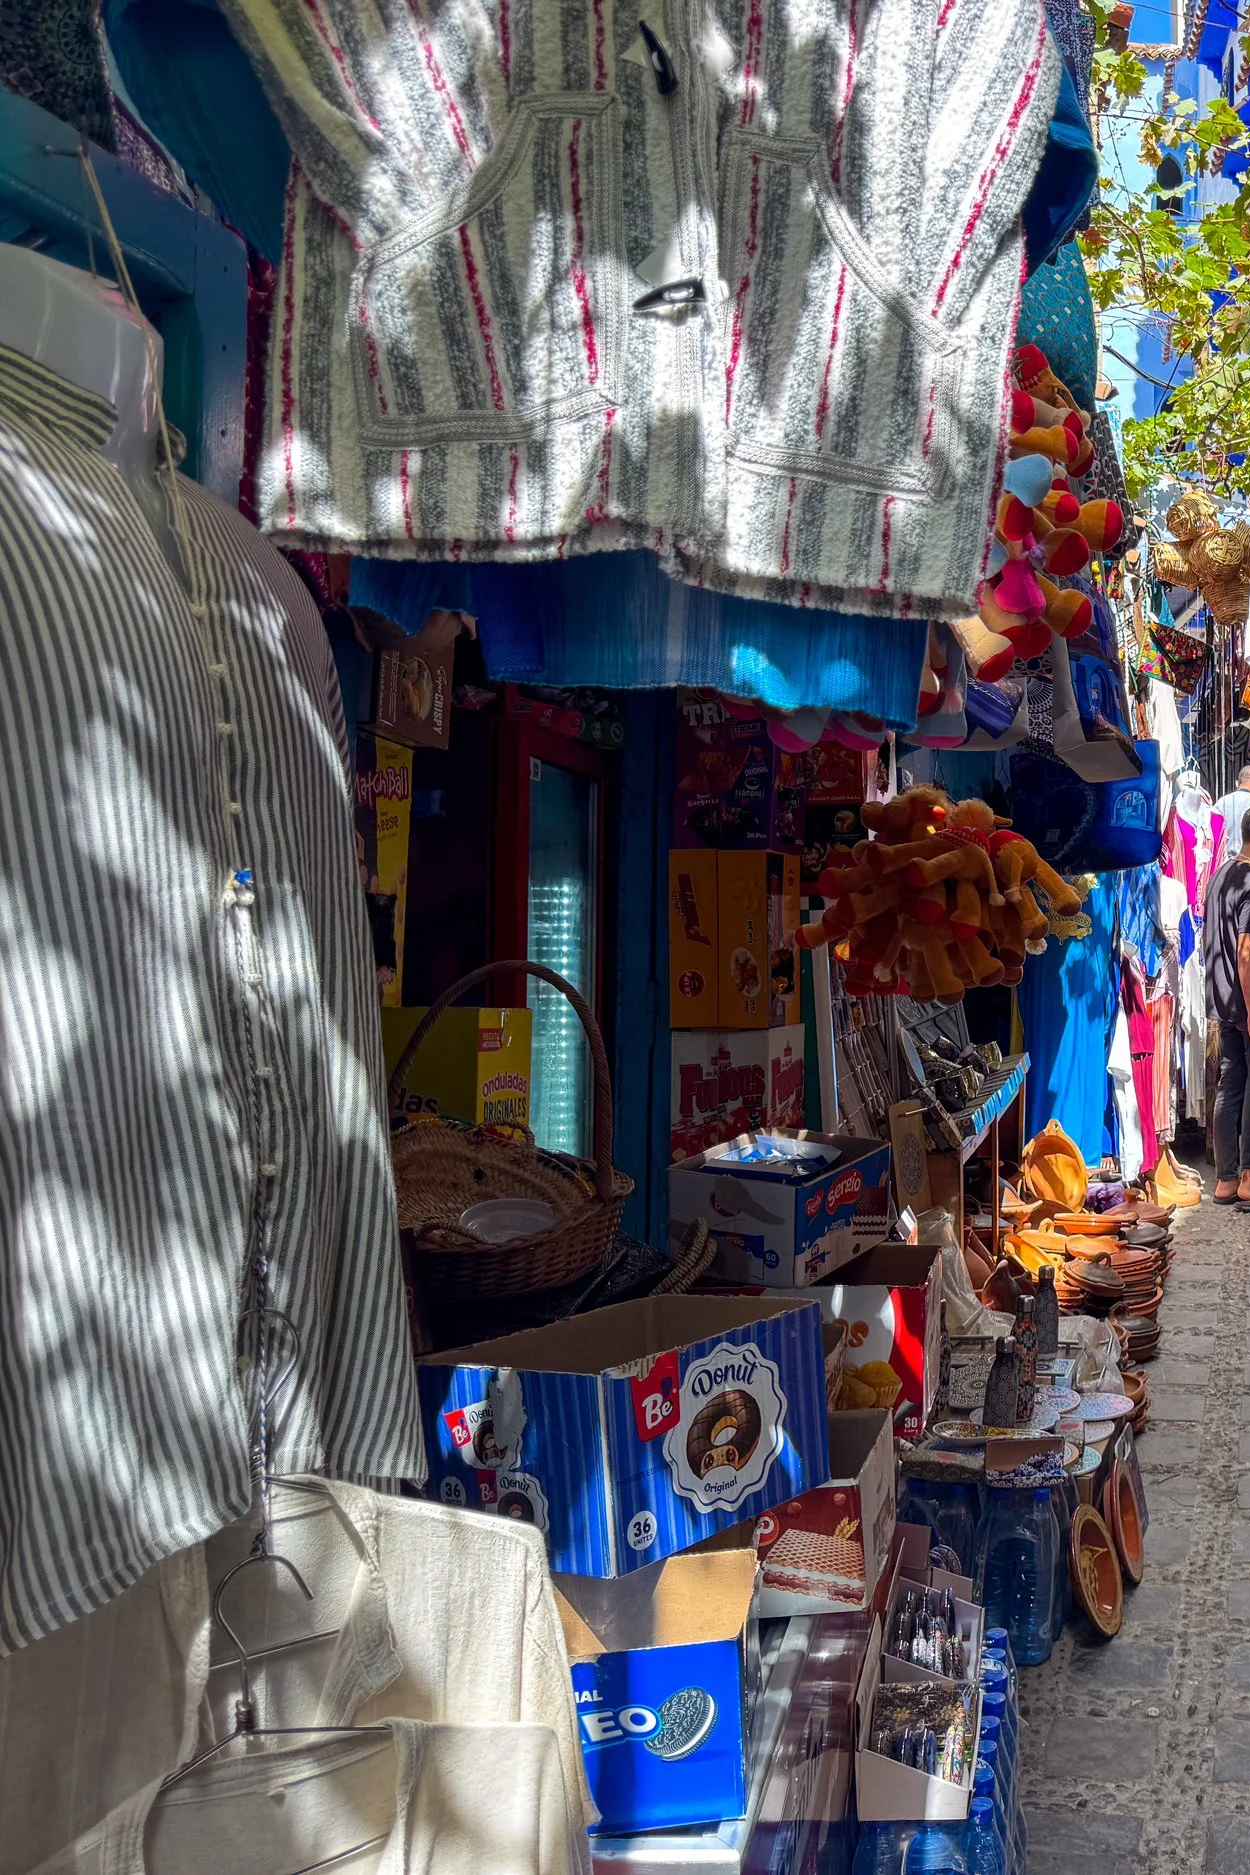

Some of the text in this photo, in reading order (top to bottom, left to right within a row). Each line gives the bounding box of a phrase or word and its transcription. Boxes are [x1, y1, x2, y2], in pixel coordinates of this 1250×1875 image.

[433, 692, 444, 735] CRISPY
[482, 1071, 528, 1098] onduladas
[483, 1098, 527, 1121] ORIGINALES
[691, 1353, 758, 1398] Donut
[904, 1416, 918, 1428] 30
[445, 1482, 461, 1498] 36
[500, 1476, 532, 1495] Donut
[704, 1475, 738, 1495] Original
[633, 1517, 651, 1538] 36
[581, 1707, 657, 1743] EO
